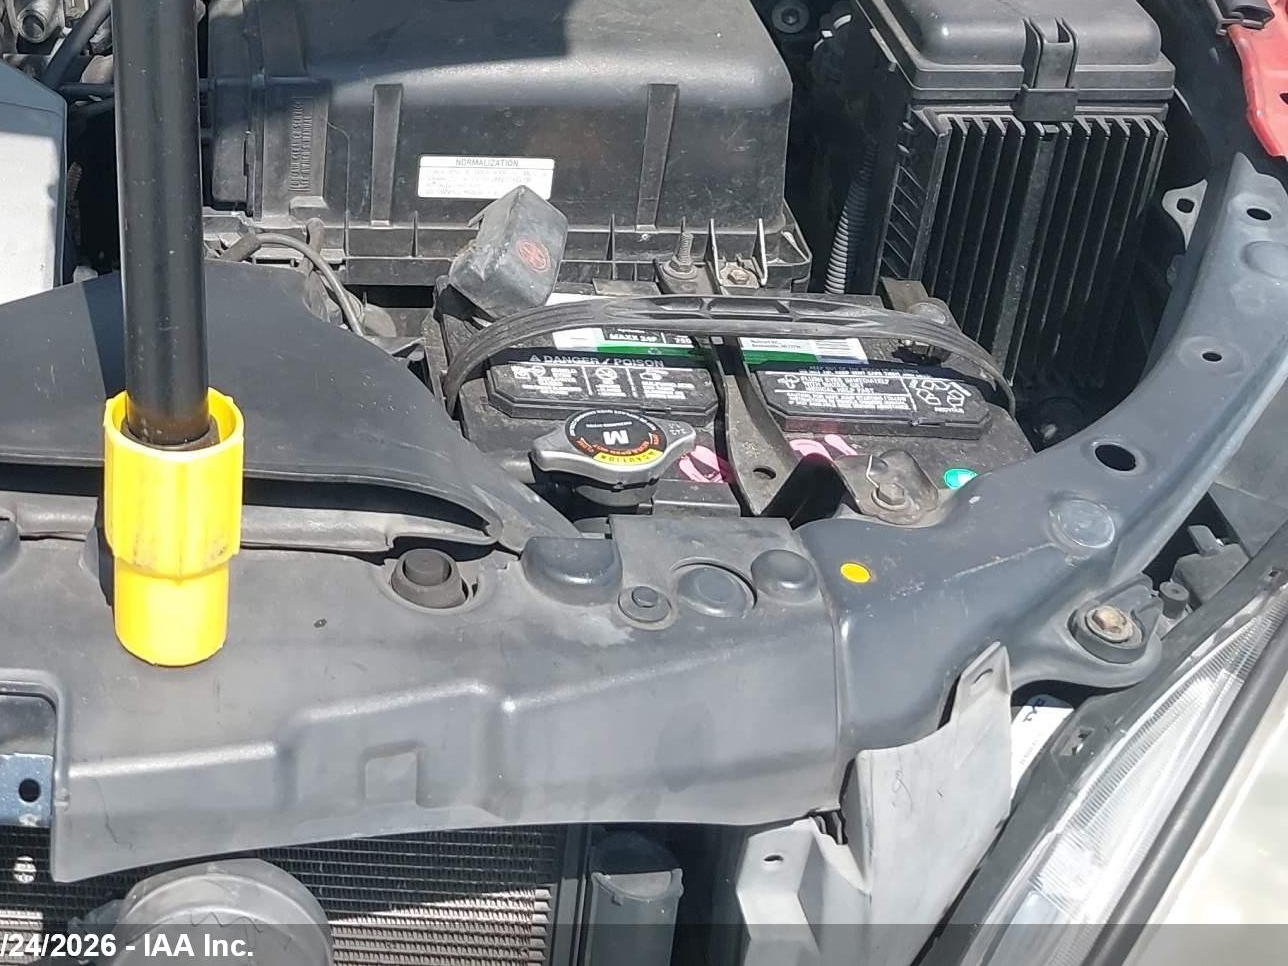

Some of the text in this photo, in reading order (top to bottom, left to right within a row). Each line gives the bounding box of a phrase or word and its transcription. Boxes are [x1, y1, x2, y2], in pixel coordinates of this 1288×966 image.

[455, 159, 519, 167] NORMALIZATION
[543, 355, 600, 366] DANGER
[613, 358, 665, 368] POISON
[603, 430, 629, 445] M
